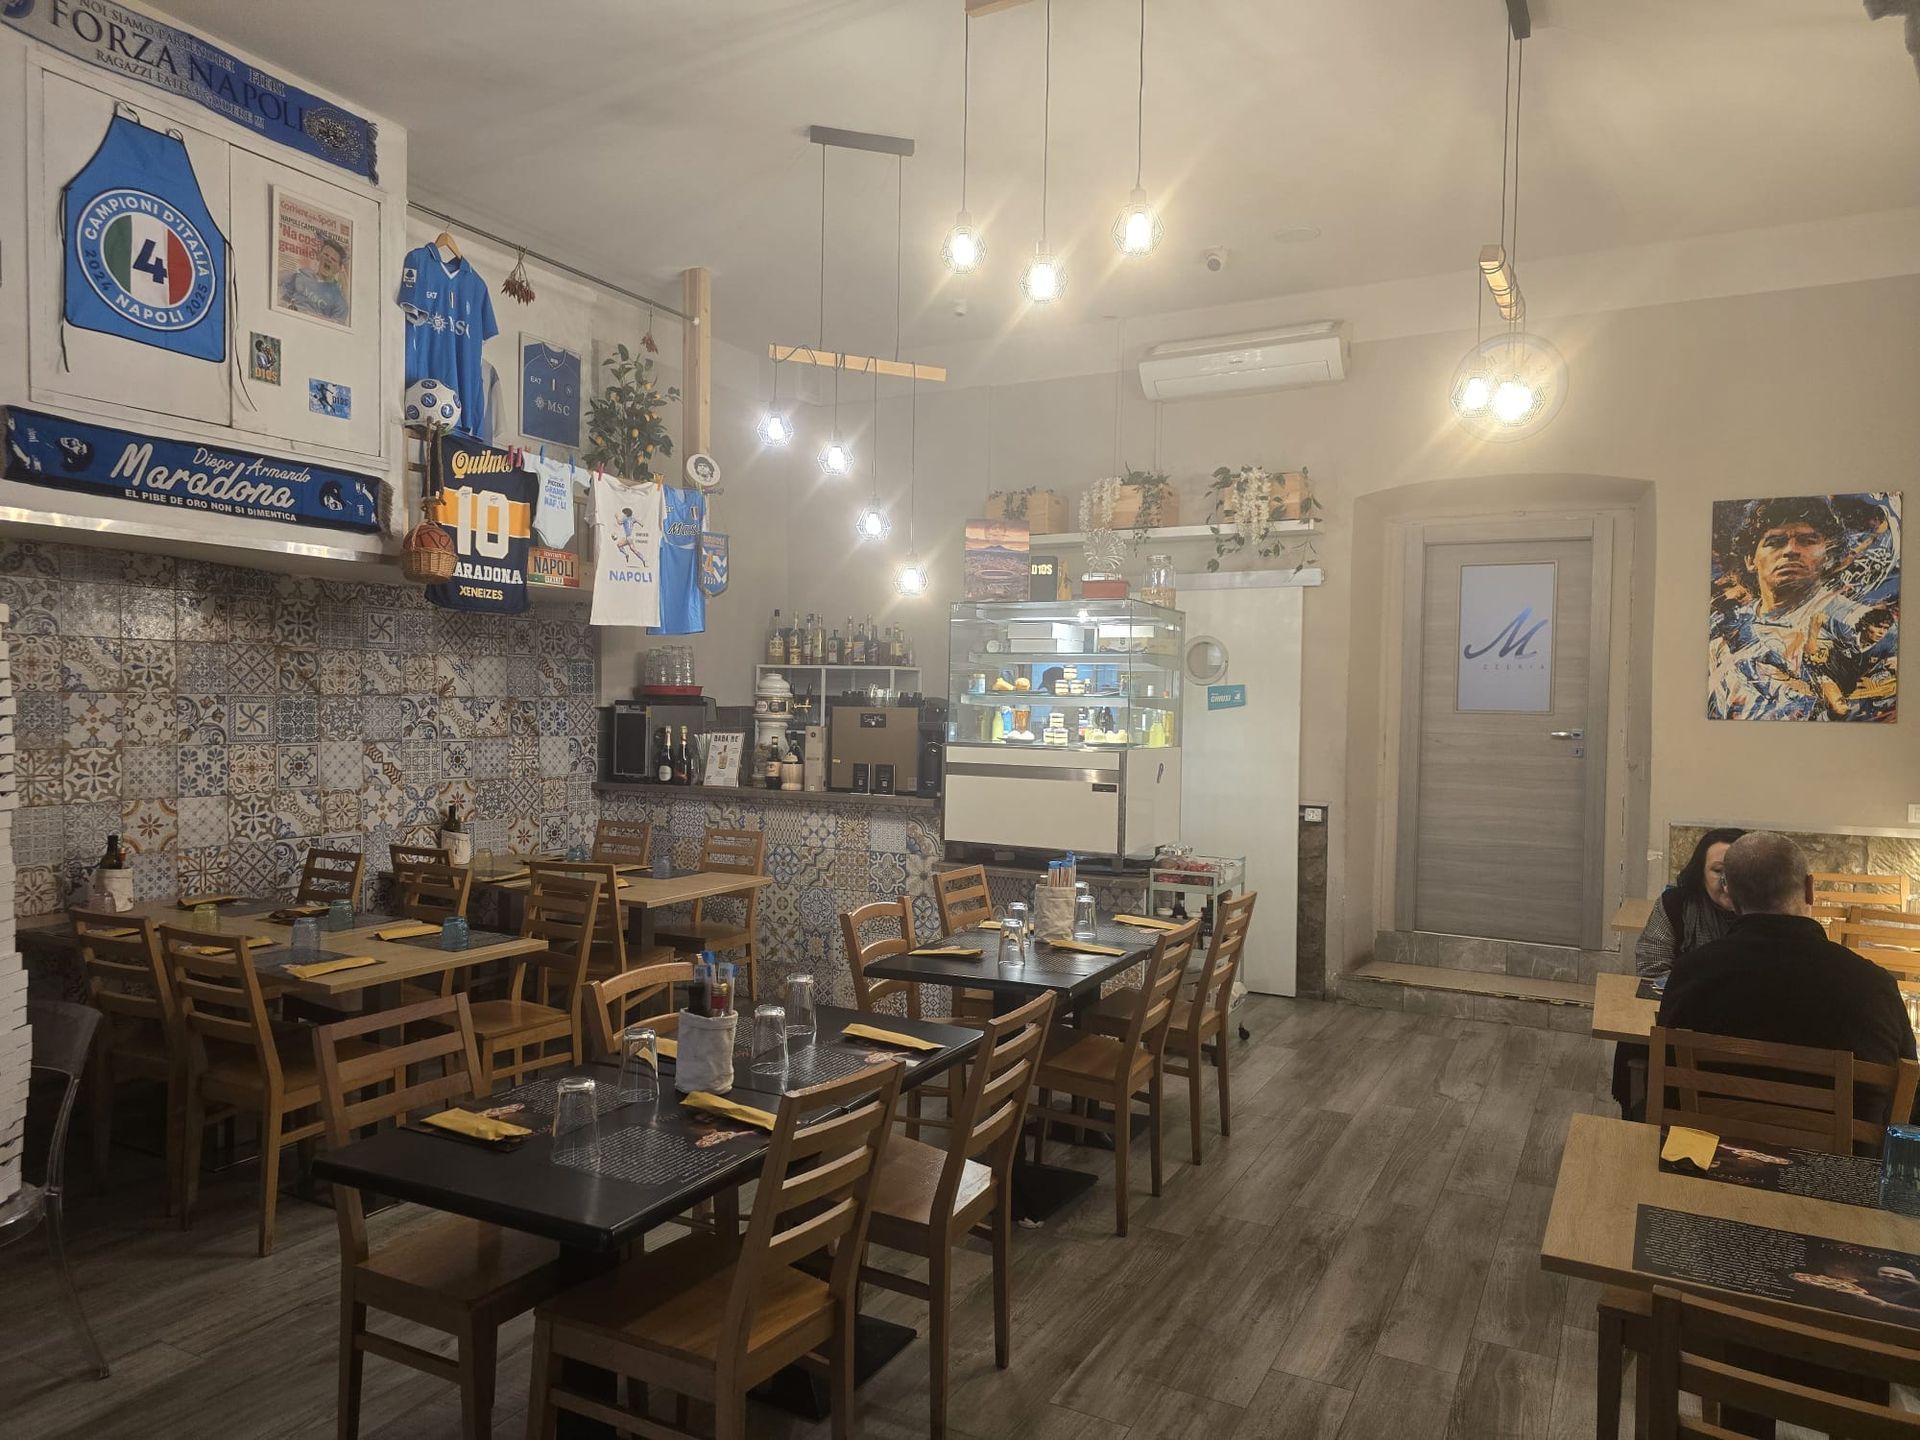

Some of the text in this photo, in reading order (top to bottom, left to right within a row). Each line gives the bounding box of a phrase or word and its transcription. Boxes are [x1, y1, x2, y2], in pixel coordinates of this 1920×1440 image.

[79, 0, 108, 17] NOI
[111, 9, 155, 36] SIAMO
[51, 0, 304, 132] FORZA NAPOLI
[96, 48, 153, 79] RAGAZZI
[85, 196, 210, 276] CAMPIONI D'ITALIA
[133, 239, 168, 284] 4
[85, 249, 208, 323] 2024 NAPOLI 2025
[547, 400, 570, 416] MSC
[110, 442, 295, 508] Maradona
[193, 447, 312, 483] Diego Armando
[125, 489, 297, 522] EL PIBE DE ORO NON SI DIMENTICA
[456, 485, 510, 560] 10
[452, 562, 523, 584] ARADONA
[534, 556, 574, 578] NAPOLI
[609, 570, 652, 583] NAPOLI
[459, 585, 503, 600] XENEIZES
